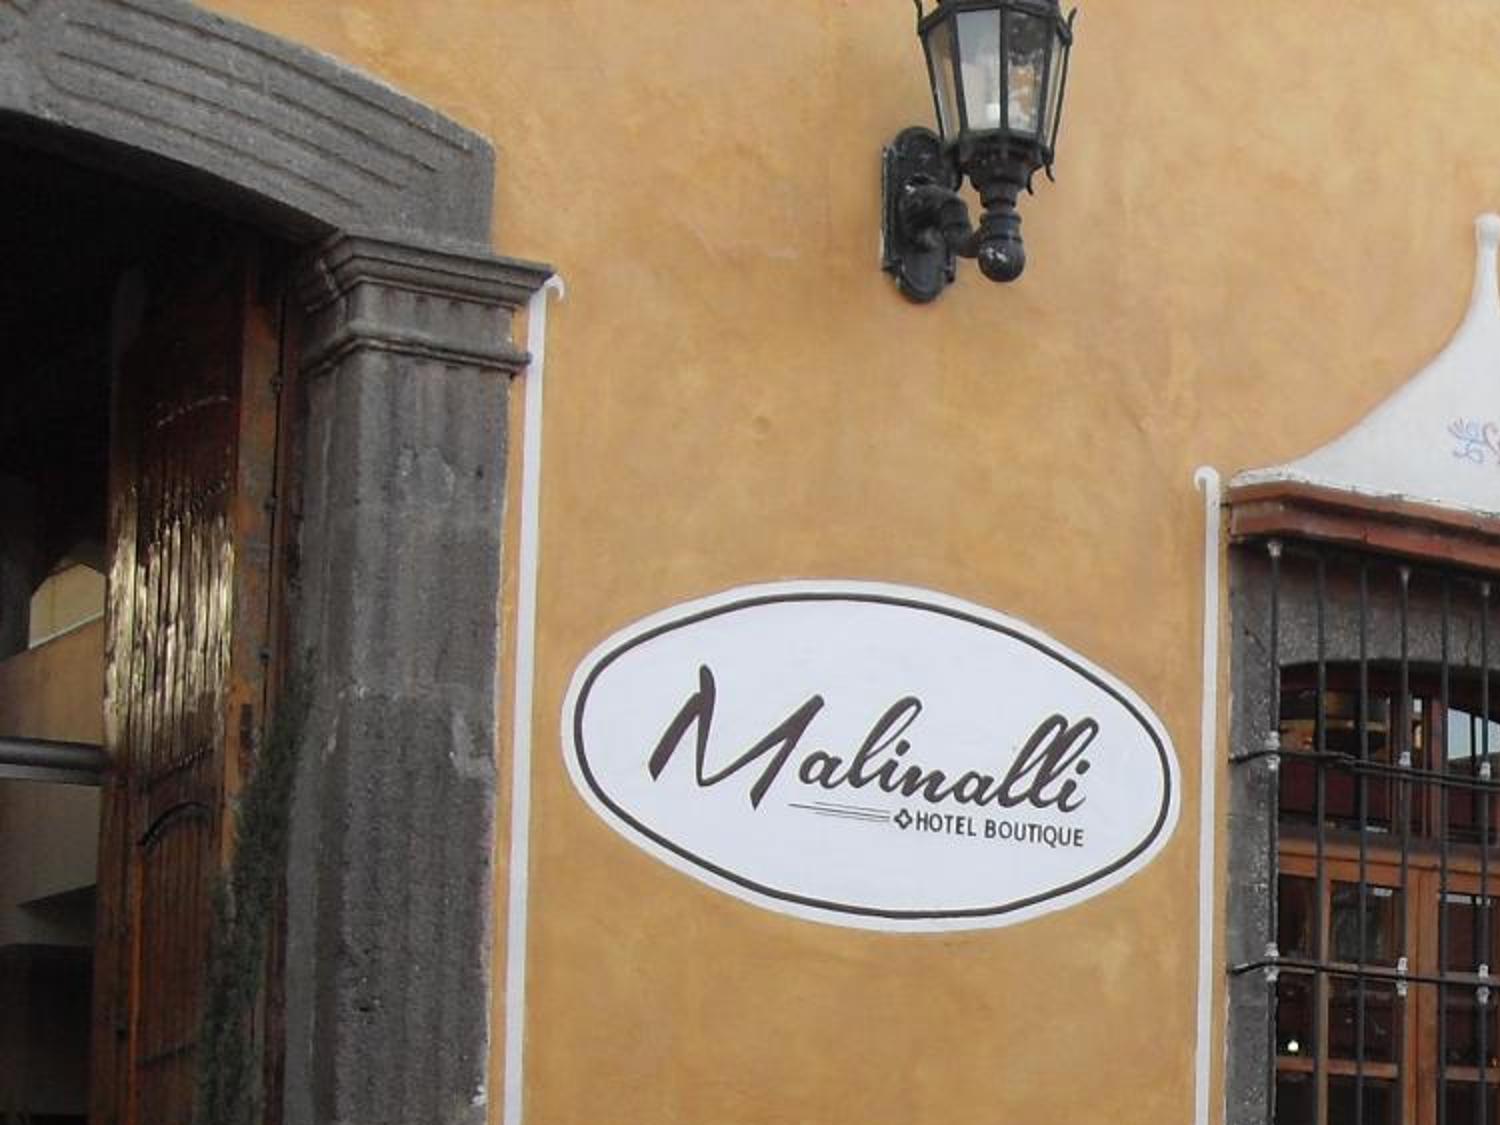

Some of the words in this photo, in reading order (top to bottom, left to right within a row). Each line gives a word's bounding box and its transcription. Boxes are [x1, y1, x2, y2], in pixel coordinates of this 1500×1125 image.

[648, 664, 1099, 811] Malinalli
[915, 812, 977, 838] HOTEL
[984, 820, 1085, 848] BOUTIQUE
